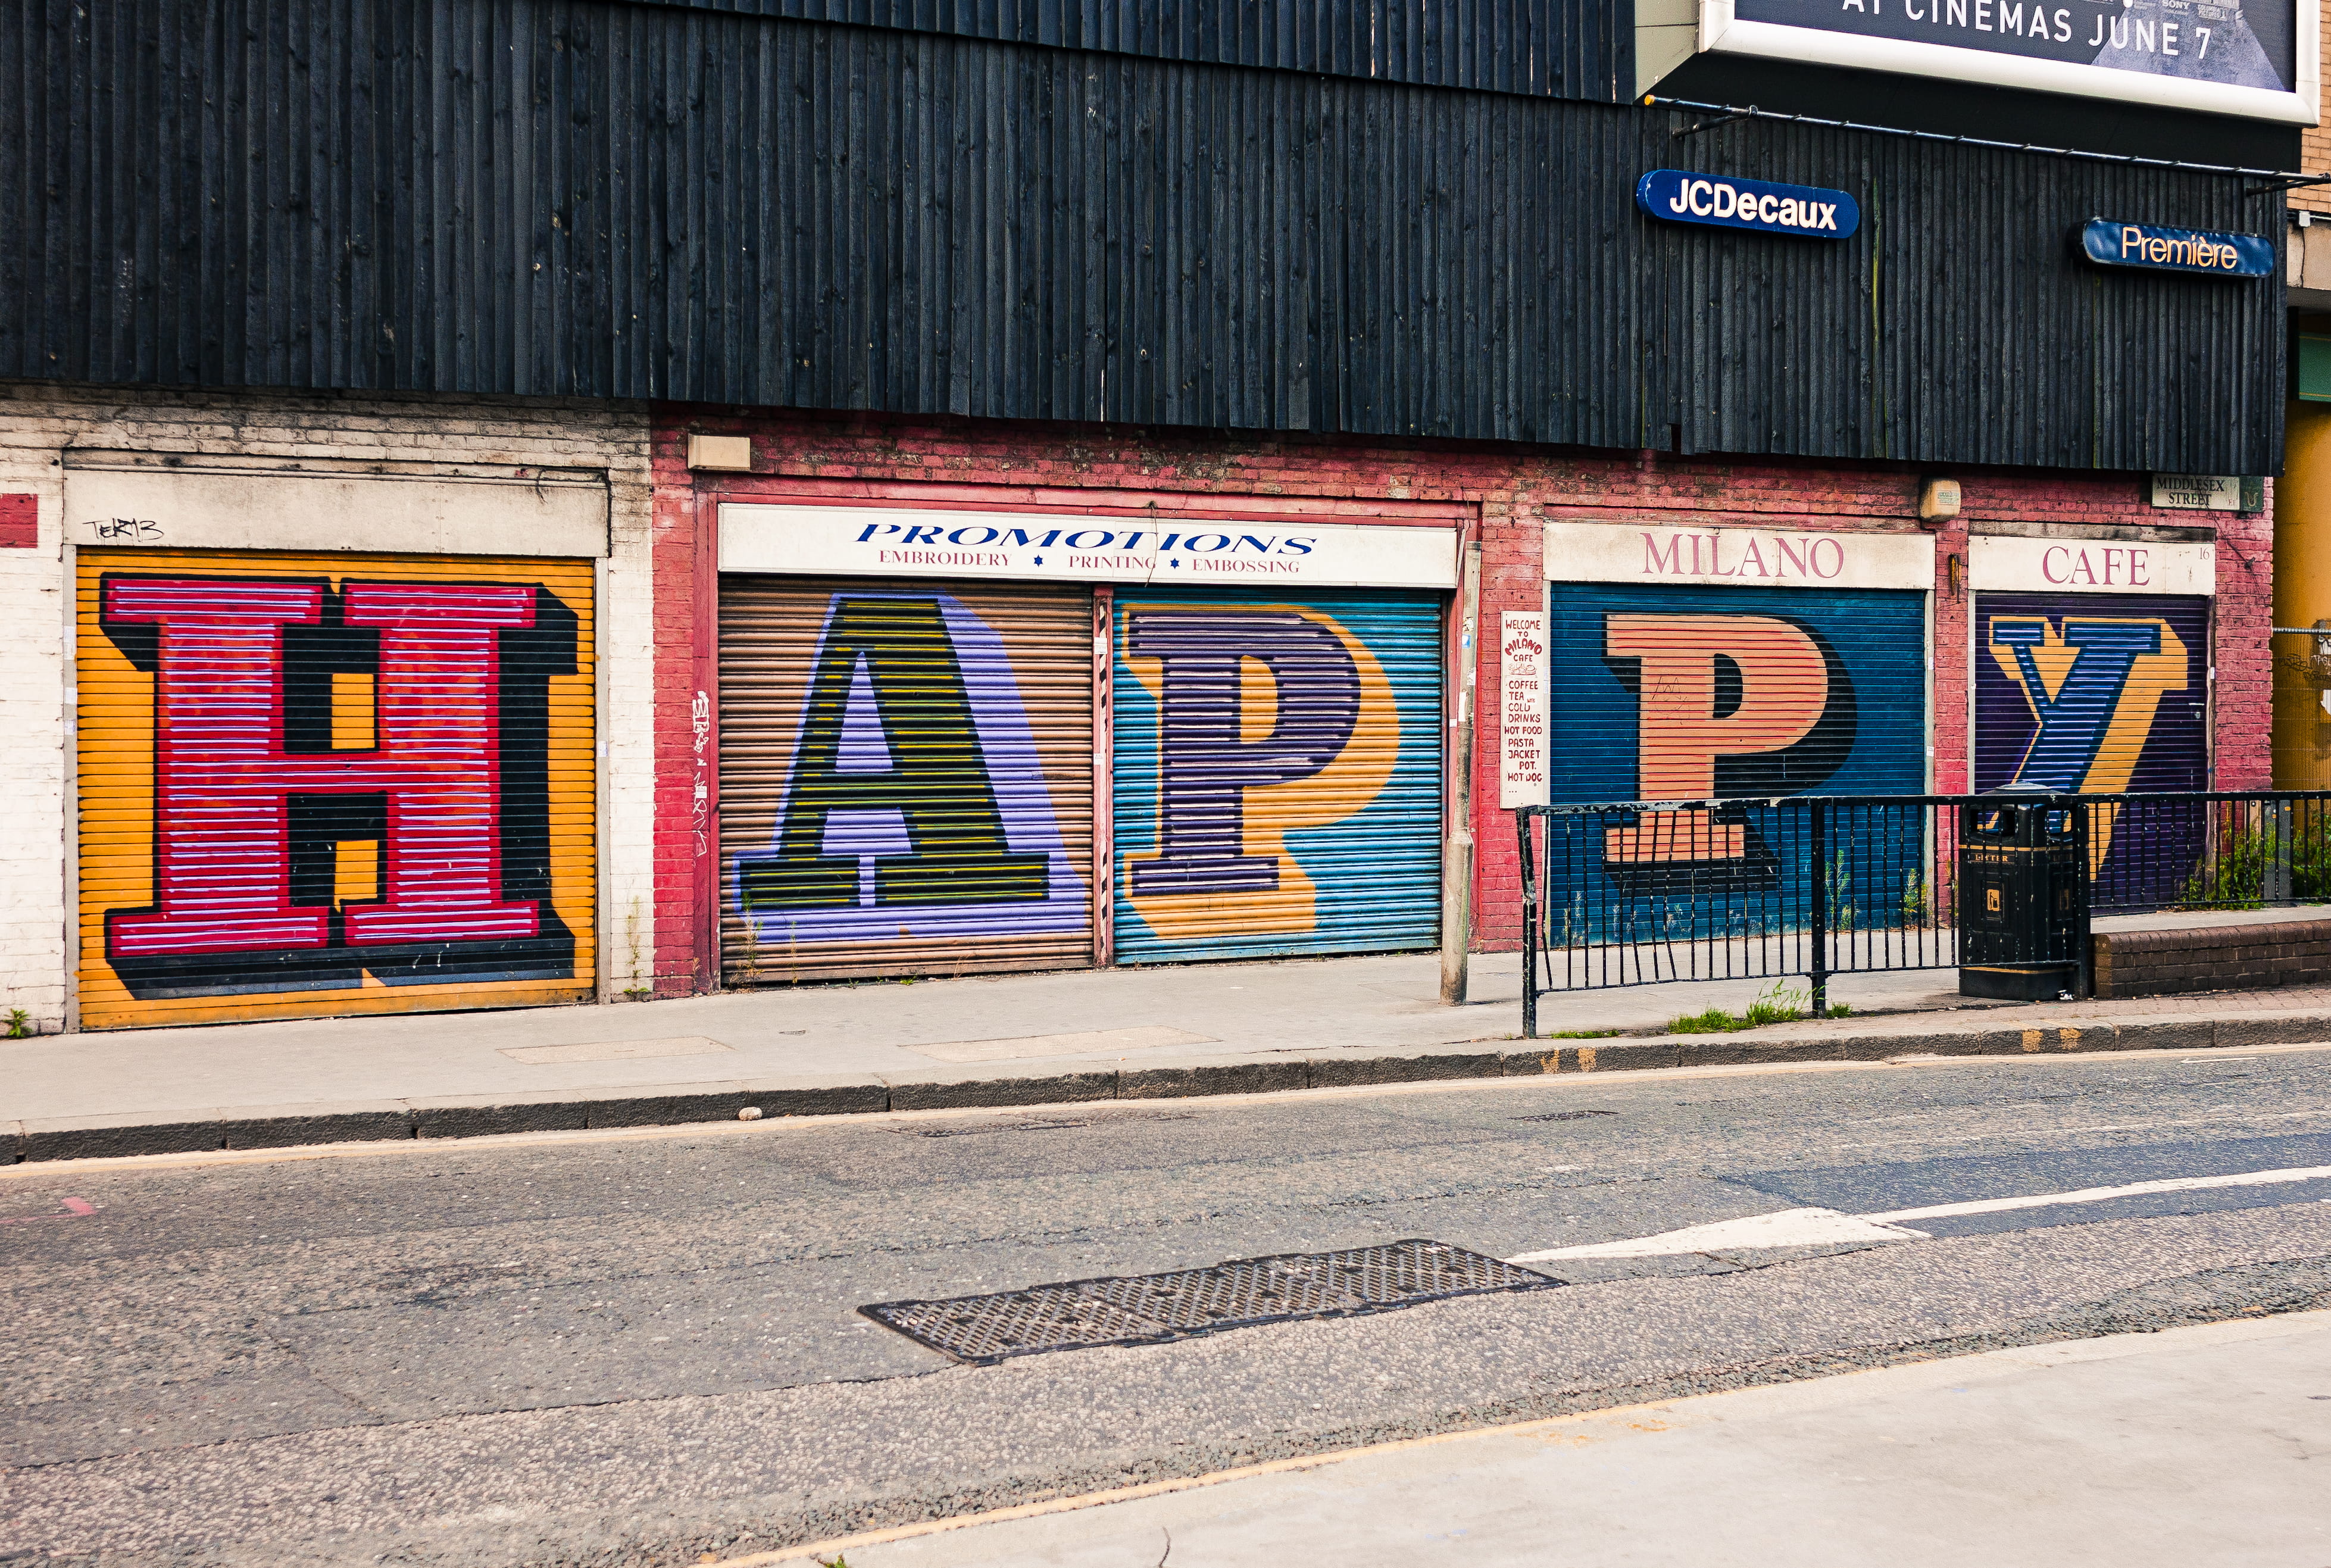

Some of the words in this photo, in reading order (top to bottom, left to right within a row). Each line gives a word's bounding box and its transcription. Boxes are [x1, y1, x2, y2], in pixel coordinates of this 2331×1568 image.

[2162, 0, 2191, 10] SONY
[1905, 0, 2072, 42] CINEMAS
[2088, 14, 2179, 56] JUNE
[2195, 27, 2211, 59] 7
[1669, 179, 1837, 230] JCDecaux
[2122, 226, 2238, 269] Première
[2157, 477, 2225, 492] MIDDLESEX
[2168, 492, 2212, 505] STREET
[852, 523, 1317, 555] PROMOTIONS
[1640, 533, 1844, 579] MILANO
[2199, 547, 2210, 560] 16
[879, 549, 1012, 566] EMBROIDERY
[1069, 555, 1157, 569] PRINTING
[1193, 558, 1299, 573] EMBOSSING
[2042, 546, 2150, 586] CAFE
[1505, 619, 1541, 630] WELCOME
[1505, 638, 1542, 655] MILANO
[1508, 680, 1539, 689] COFFEE
[1508, 692, 1524, 701] TEA
[1508, 713, 1541, 723] DRINKS
[1504, 726, 1520, 735] HOT
[1523, 726, 1542, 735] FOOD
[1508, 738, 1534, 747] PASTA
[1508, 750, 1541, 759] JACKET
[1519, 761, 1537, 770] POT.
[1508, 773, 1524, 782] HOT
[1526, 773, 1543, 782] DOG
